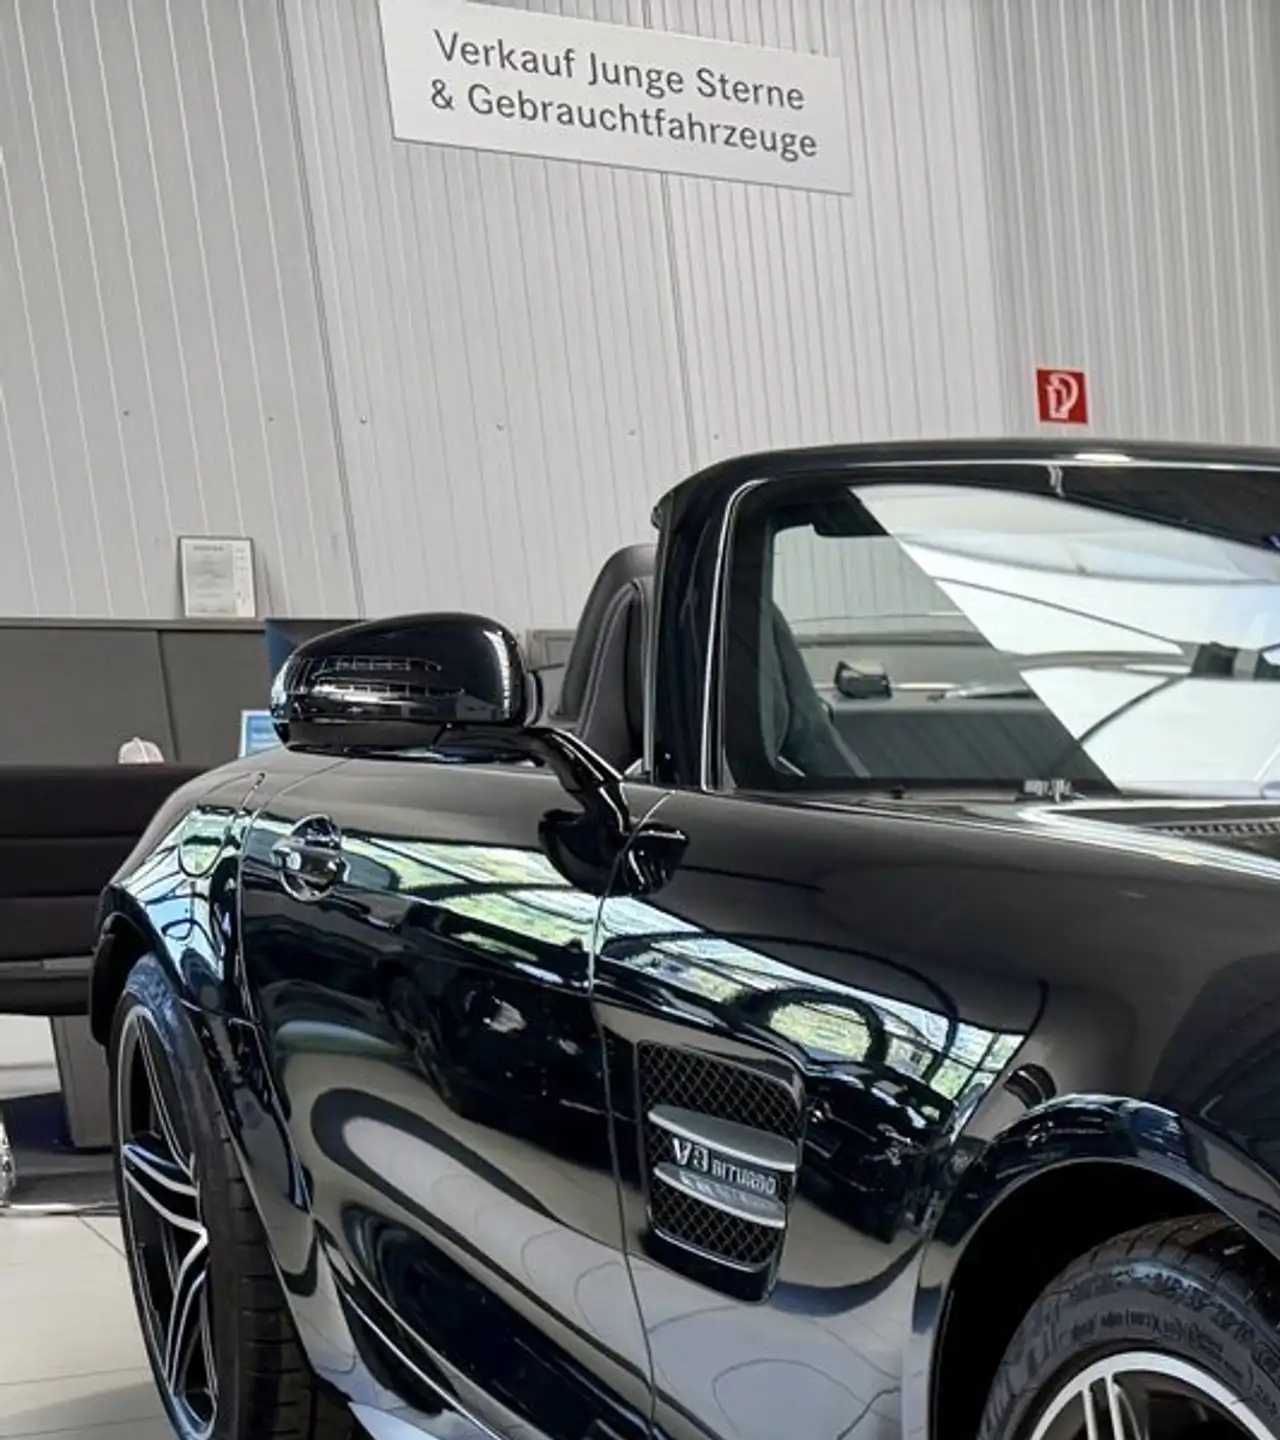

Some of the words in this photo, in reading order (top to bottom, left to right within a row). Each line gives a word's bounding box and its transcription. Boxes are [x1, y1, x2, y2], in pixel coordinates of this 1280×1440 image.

[434, 29, 575, 79] Verkauf
[588, 53, 684, 99] Junge
[695, 67, 806, 111] Sterne
[431, 78, 454, 110] &
[466, 83, 818, 162] Gebrauchtfahrzeuge
